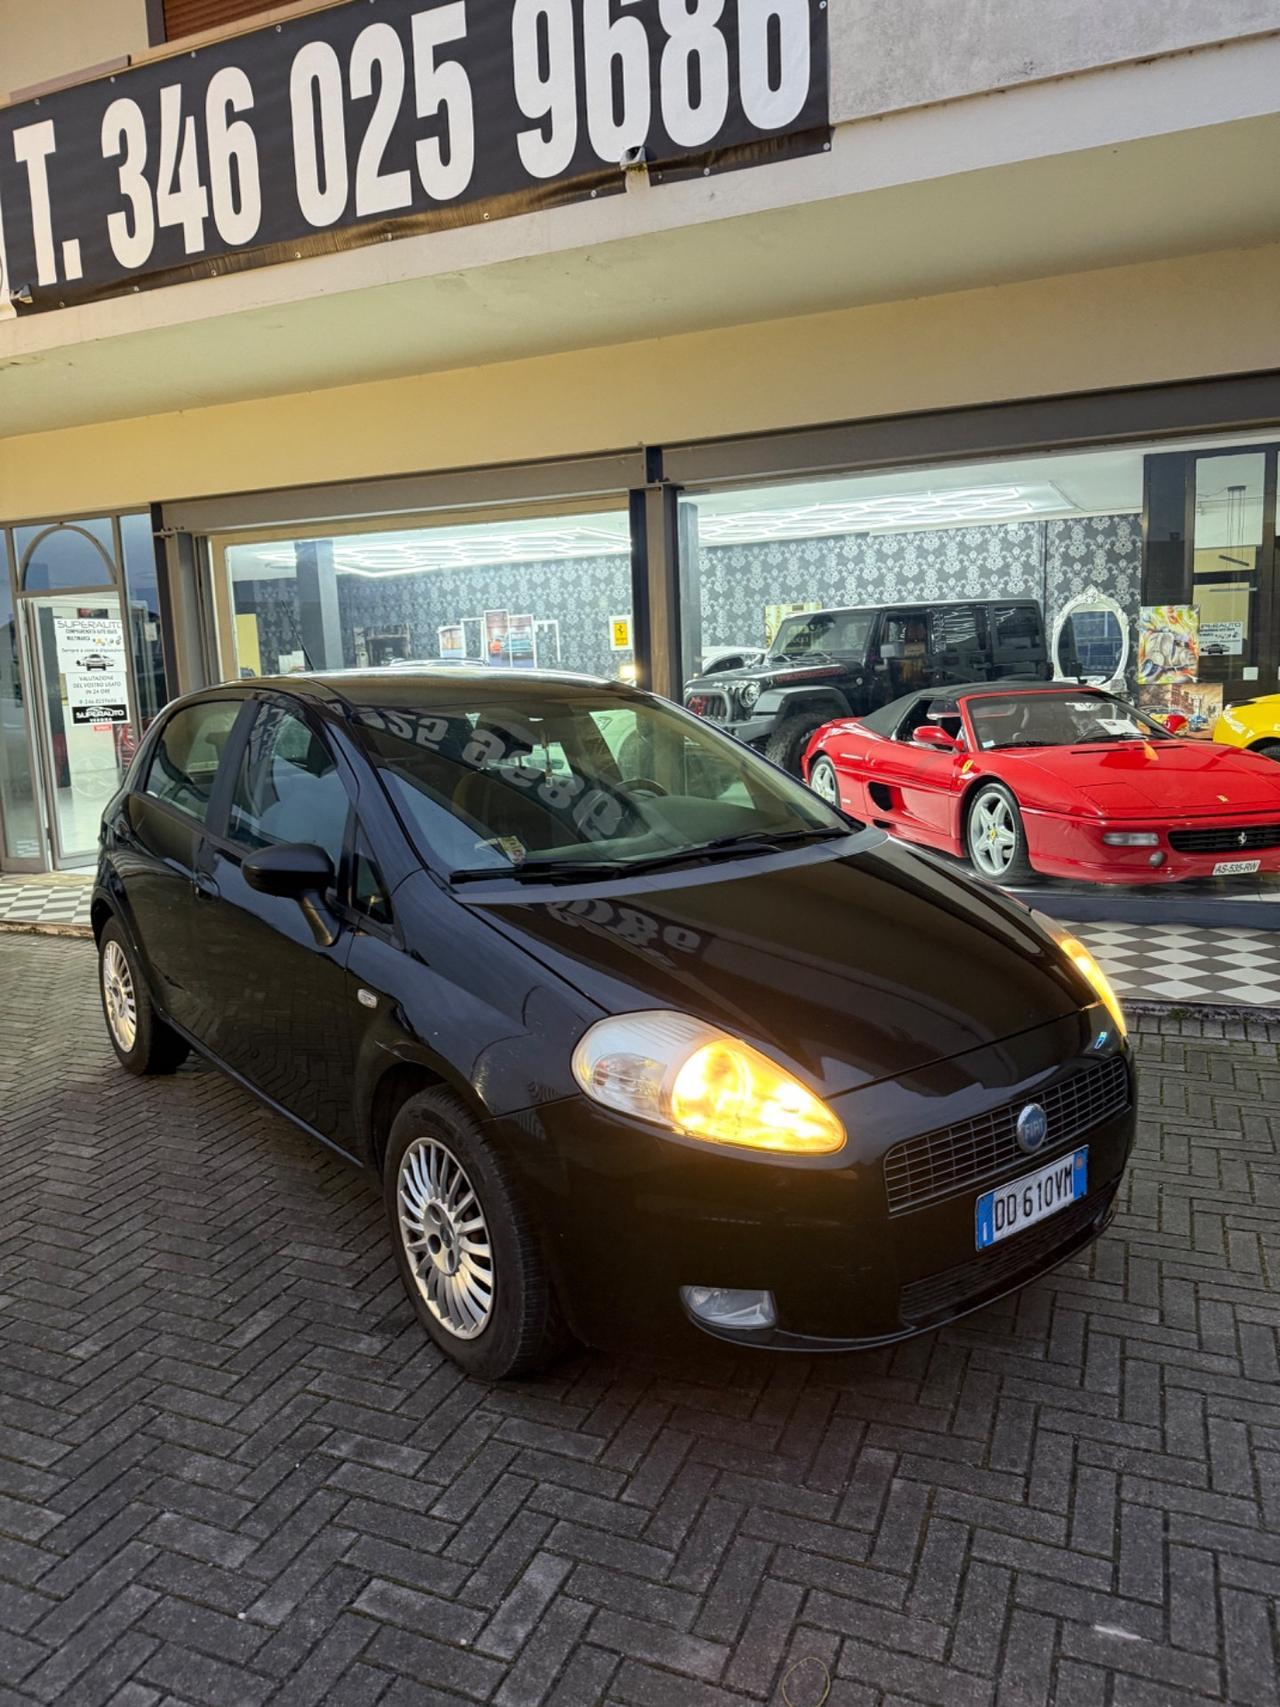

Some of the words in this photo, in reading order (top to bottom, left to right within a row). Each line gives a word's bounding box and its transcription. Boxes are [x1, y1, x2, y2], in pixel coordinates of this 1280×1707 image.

[13, 119, 84, 287] T.
[101, 65, 261, 269] 346
[290, 0, 474, 227] 025
[1022, 1118, 1045, 1141] FIAT
[994, 1194, 1017, 1232] DD
[1023, 1163, 1073, 1217] 610VM
